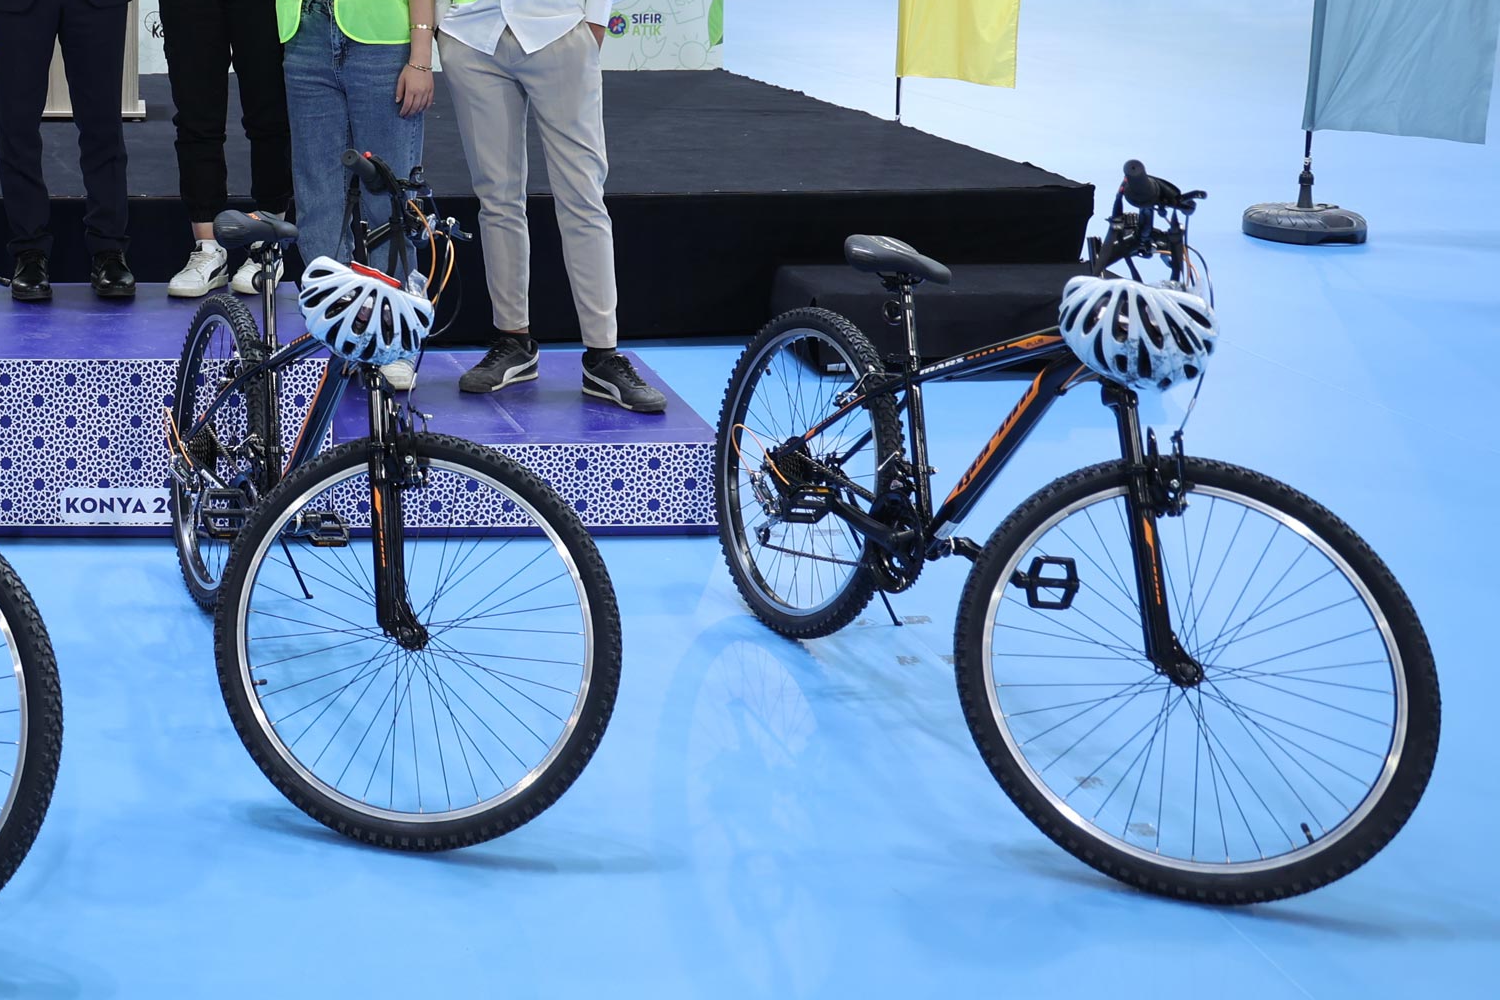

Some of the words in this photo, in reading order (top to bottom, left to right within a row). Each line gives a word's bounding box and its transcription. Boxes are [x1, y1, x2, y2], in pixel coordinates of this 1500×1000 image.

[631, 13, 662, 24] SIFIR
[632, 24, 662, 36] ATIK
[919, 356, 965, 376] MARS
[65, 496, 148, 514] KONYA
[152, 496, 173, 514] 2
